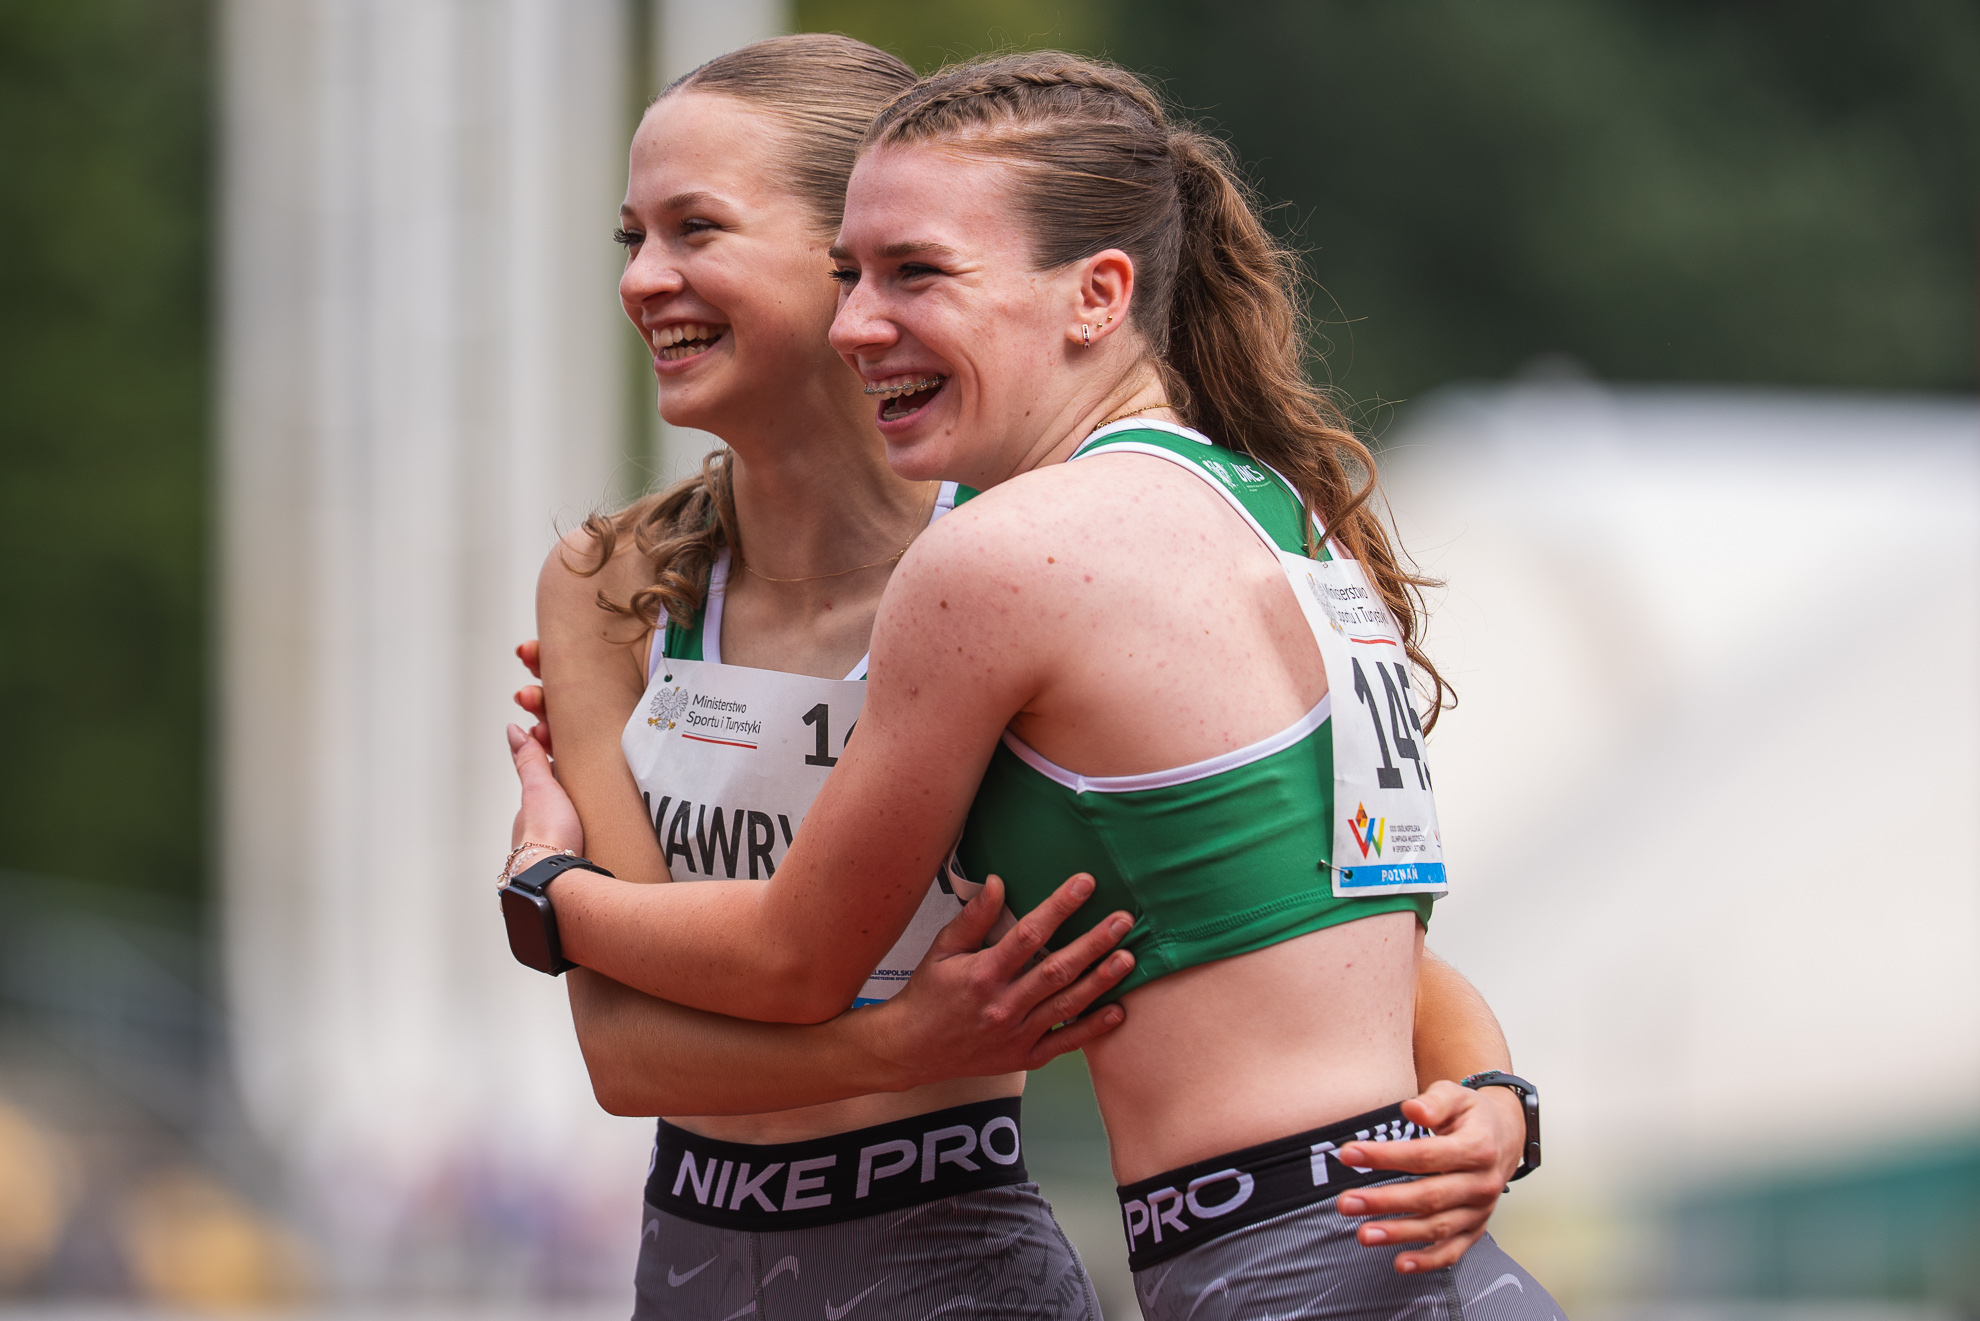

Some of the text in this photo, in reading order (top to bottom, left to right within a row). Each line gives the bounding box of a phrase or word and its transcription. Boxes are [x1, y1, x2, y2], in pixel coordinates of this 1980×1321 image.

[686, 710, 762, 735] Sportu i Turystyki
[692, 693, 747, 714] Ministerstwo
[801, 702, 861, 768] 1
[1381, 864, 1419, 882] POZNAŃ
[671, 1150, 837, 1213] NIKE
[855, 1116, 1020, 1200] PRO
[1124, 1168, 1255, 1252] PRO
